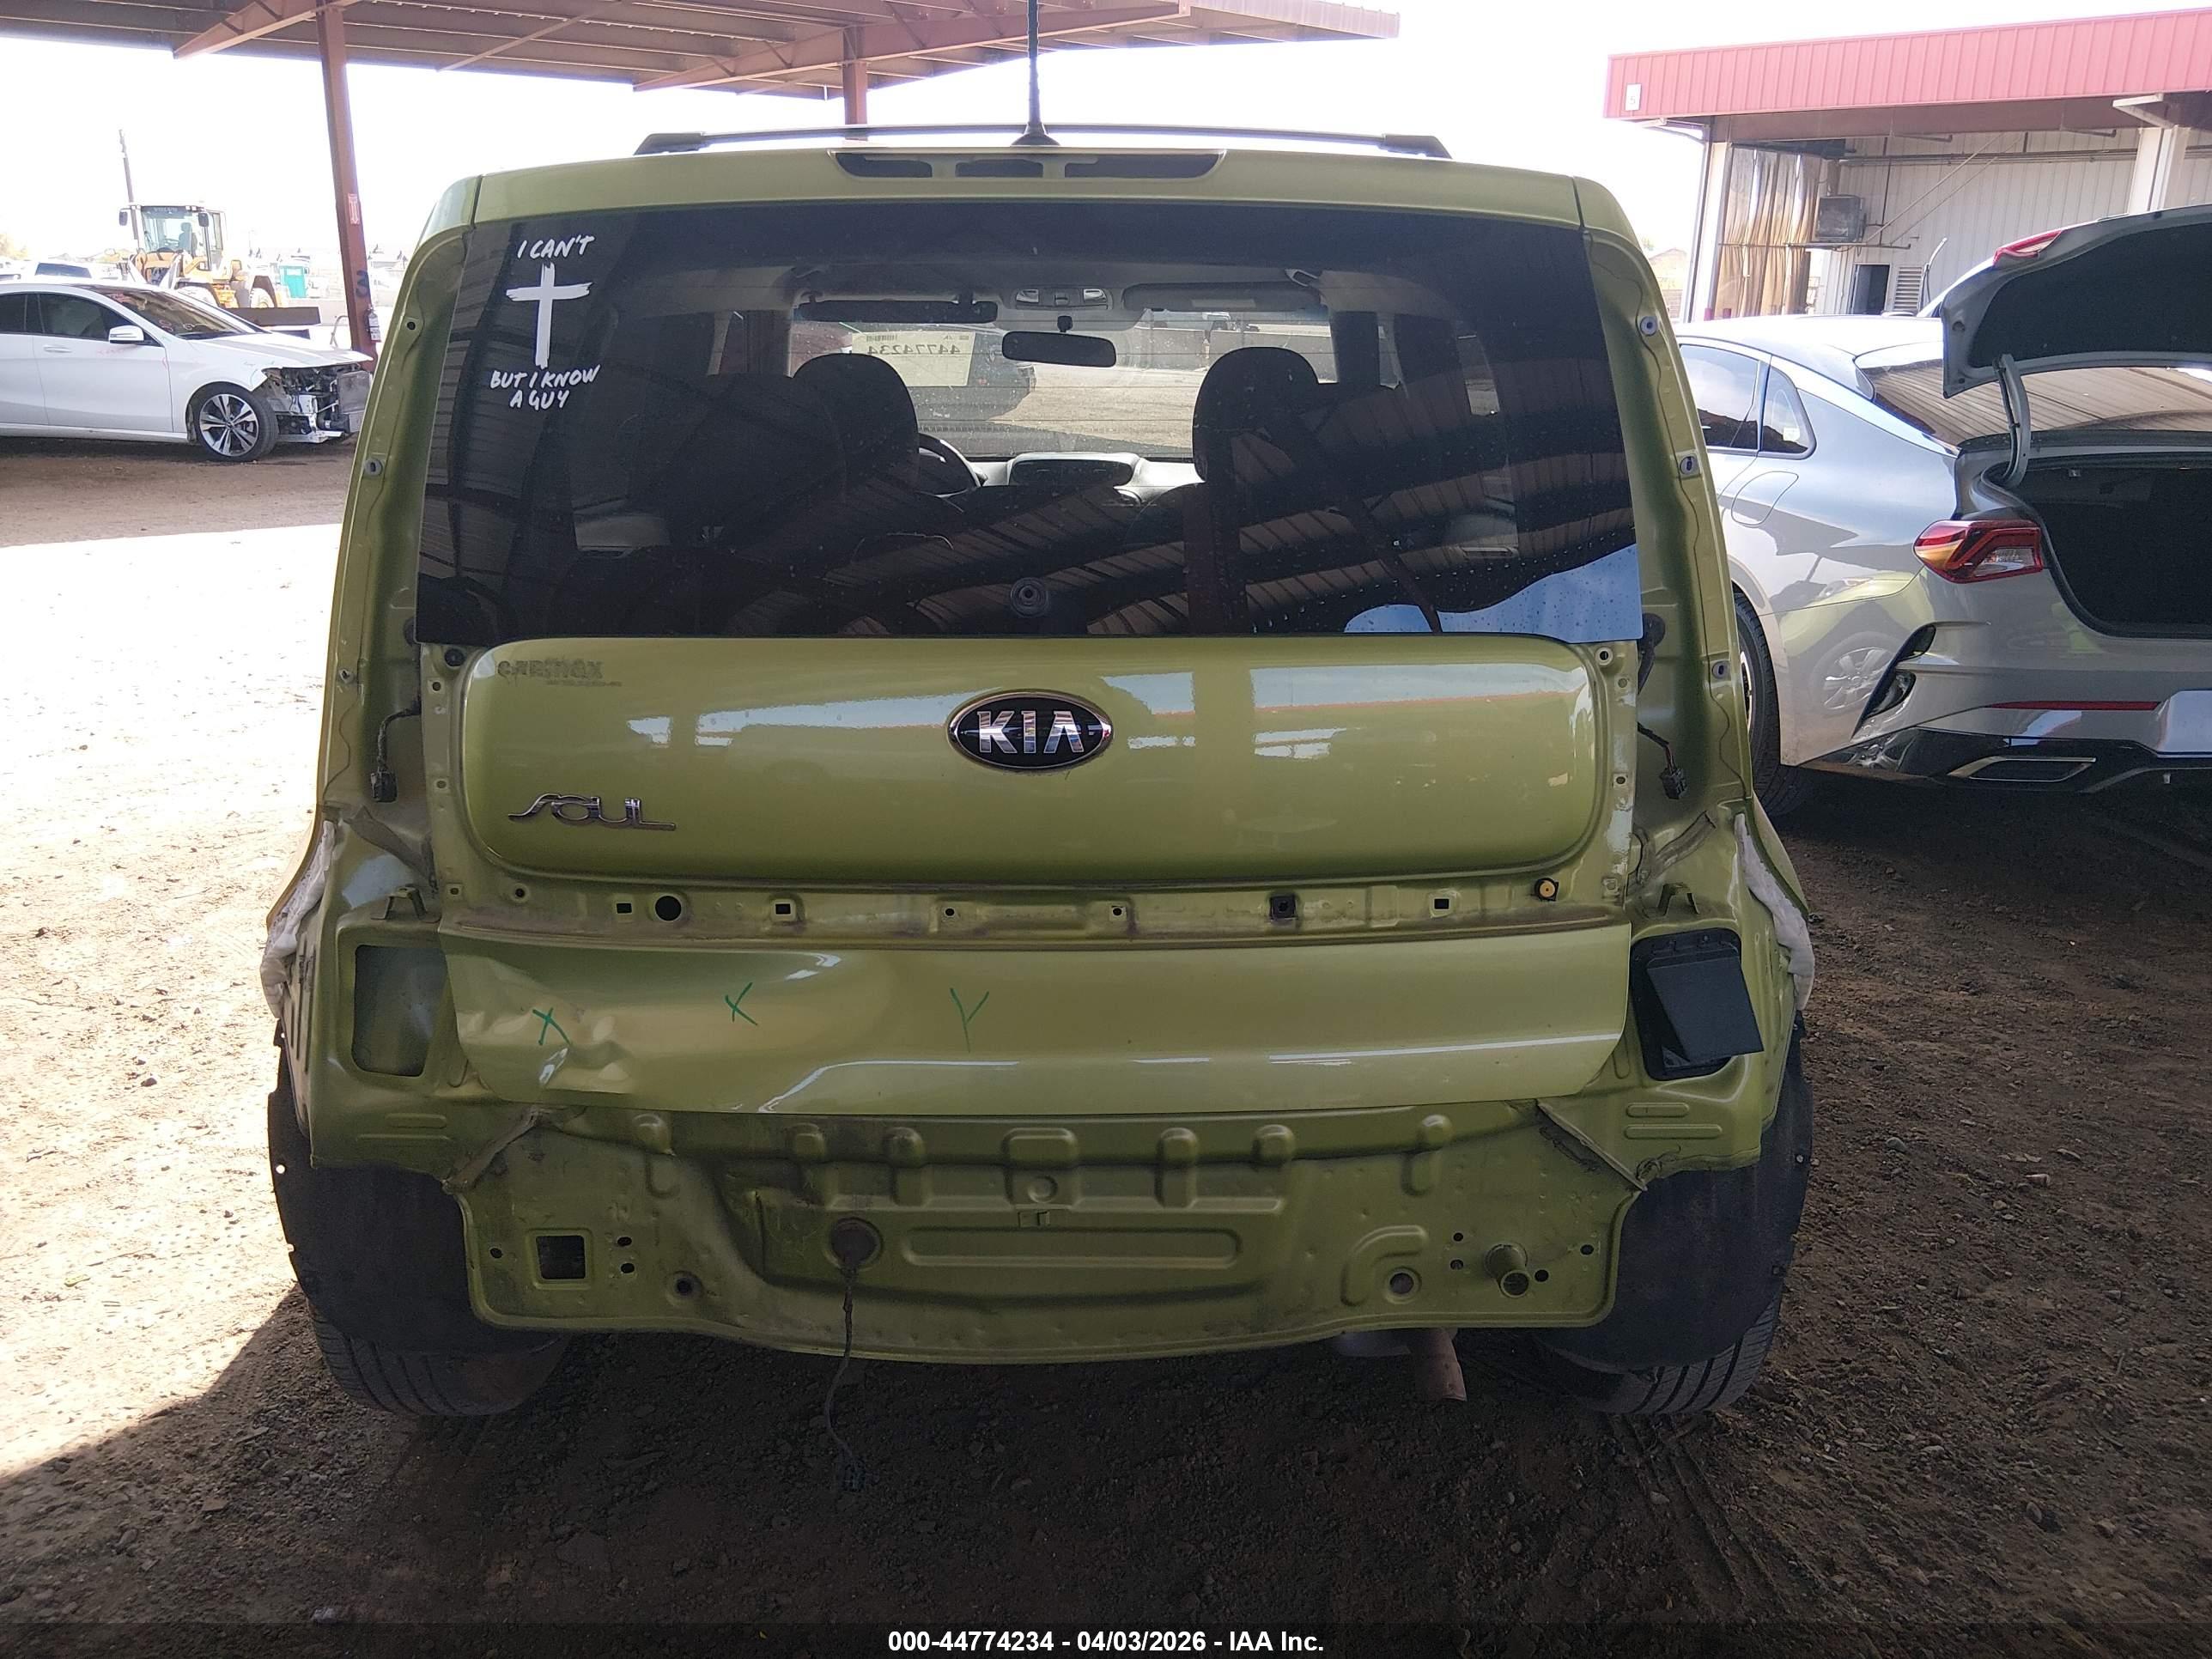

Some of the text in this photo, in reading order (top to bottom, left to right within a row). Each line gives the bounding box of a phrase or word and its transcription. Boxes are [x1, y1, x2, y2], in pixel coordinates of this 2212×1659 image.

[517, 234, 595, 259] I CAN'T
[490, 364, 601, 389] BUT I KNOW
[509, 389, 570, 410] A GUY
[976, 710, 1085, 754] KIA
